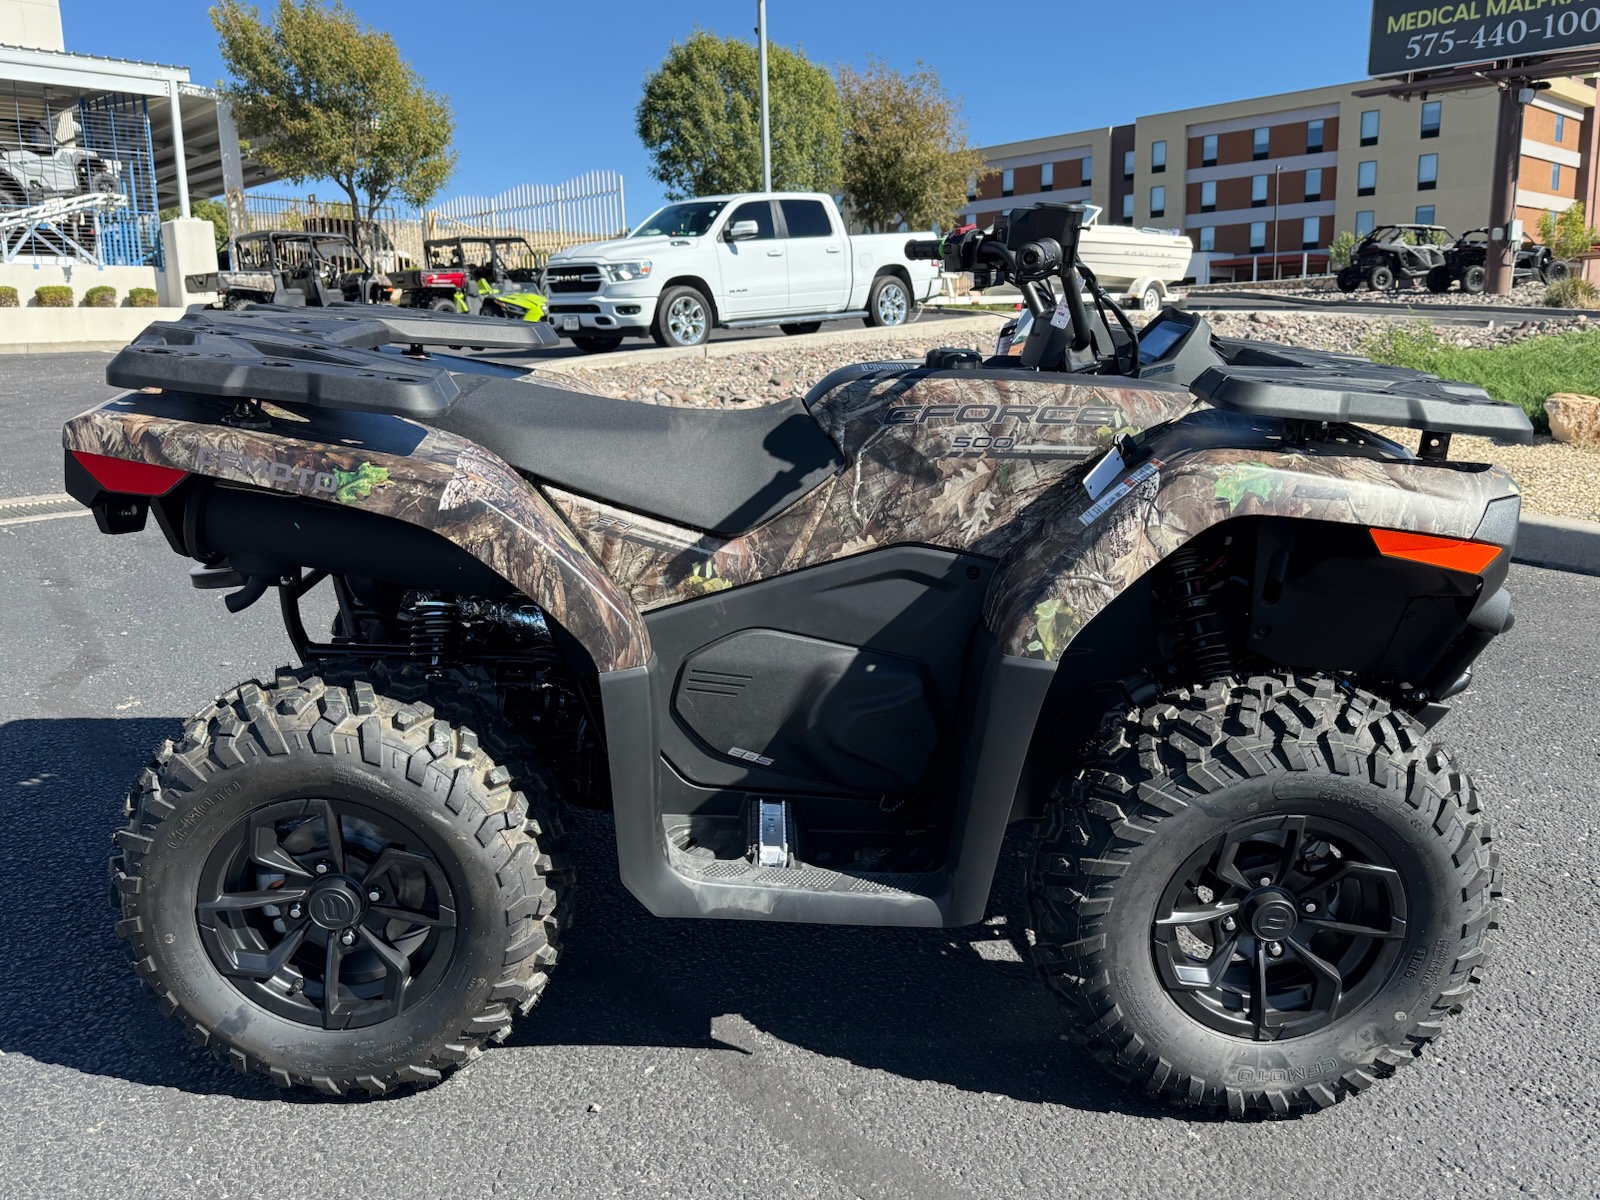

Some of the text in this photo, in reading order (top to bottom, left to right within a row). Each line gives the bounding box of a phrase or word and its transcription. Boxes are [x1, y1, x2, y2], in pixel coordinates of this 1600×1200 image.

[1387, 6, 1481, 34] MEDICAL
[1141, 363, 1176, 378] EPS
[883, 404, 1118, 427] CFORCE
[951, 436, 1015, 449] 500
[197, 447, 338, 494] CFMOTO
[1237, 1057, 1338, 1085] CFMOTO
